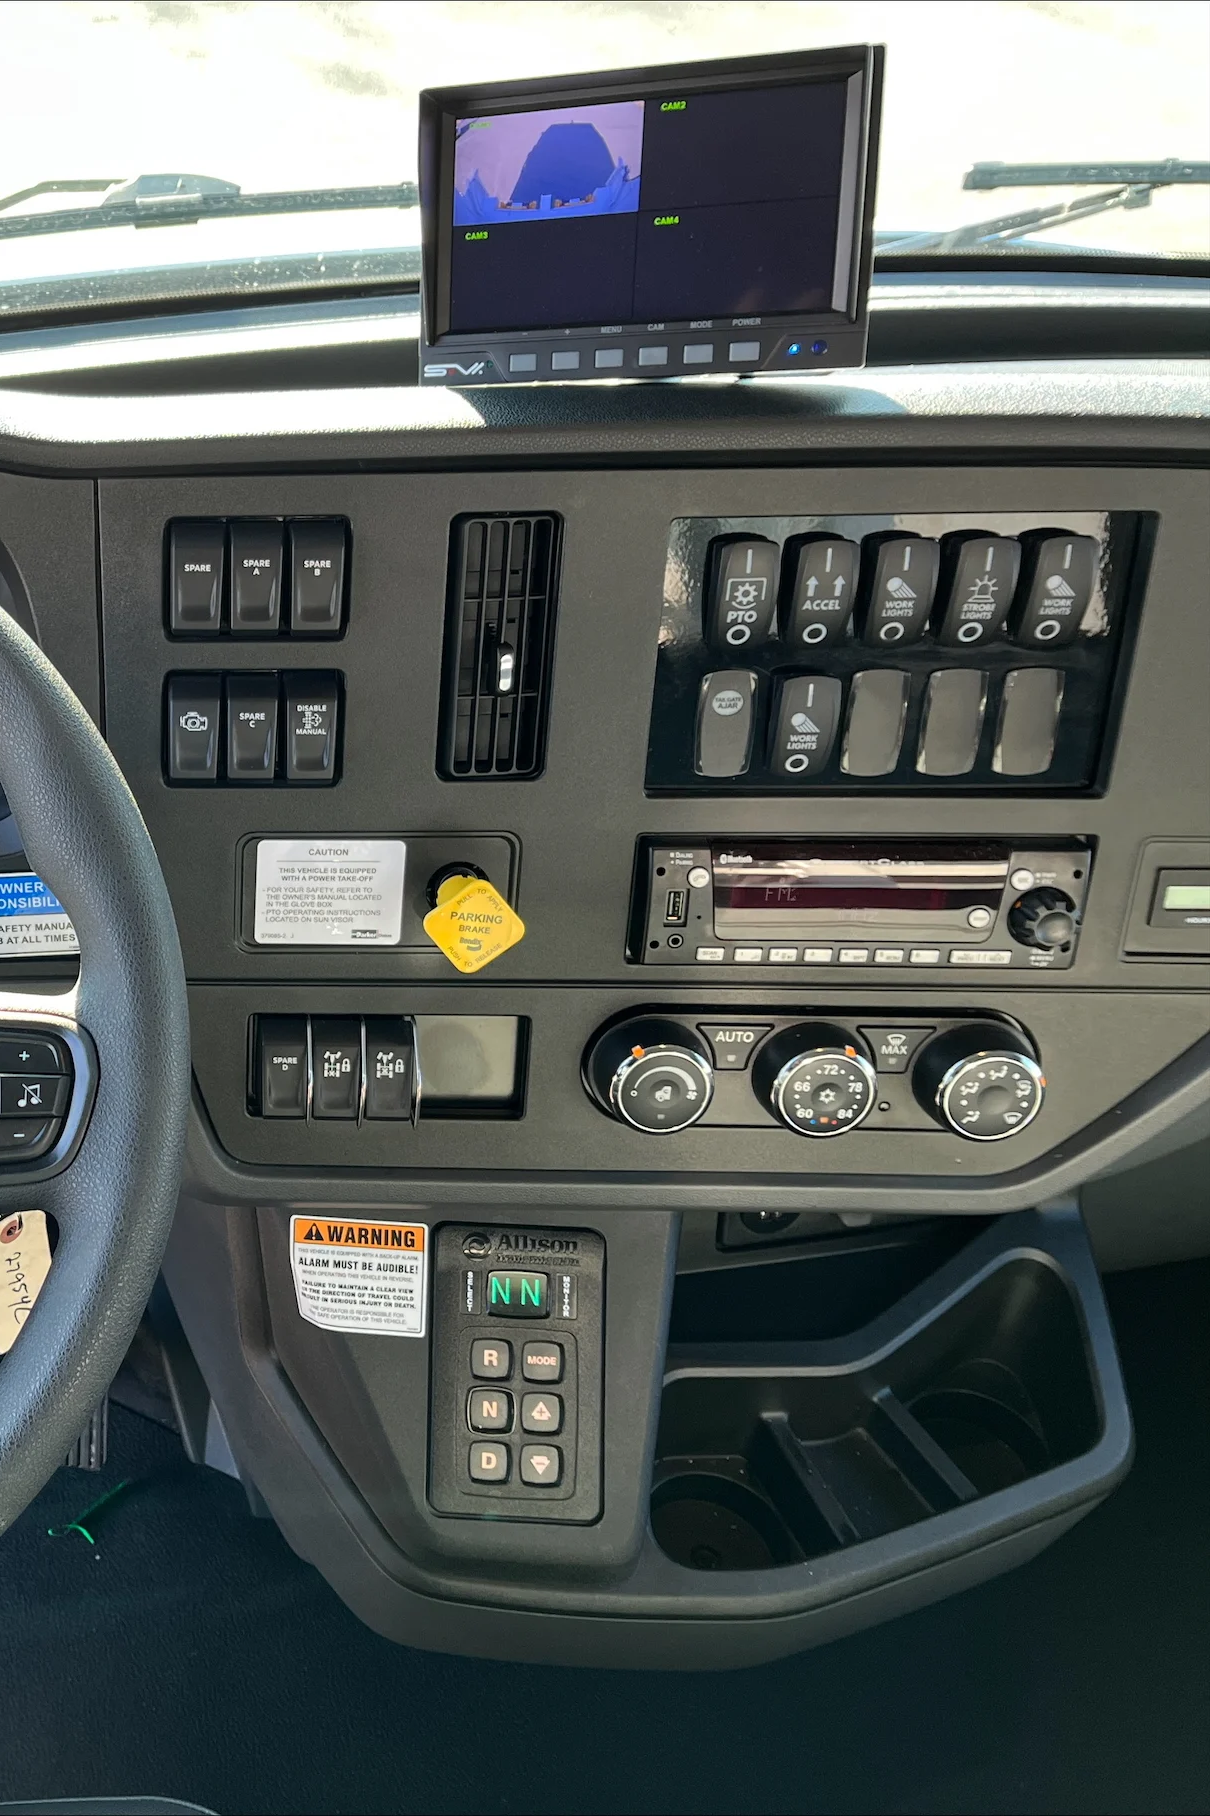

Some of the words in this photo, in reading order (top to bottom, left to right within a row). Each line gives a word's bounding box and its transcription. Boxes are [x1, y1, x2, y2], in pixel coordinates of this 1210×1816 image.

[660, 101, 686, 111] CAM2
[654, 216, 679, 226] CAM4
[465, 231, 489, 240] CAM3
[601, 326, 622, 334] MENU
[648, 323, 664, 331] CAM
[690, 321, 712, 329] MODE
[733, 318, 761, 326] POWER
[184, 564, 211, 572] SPARE
[304, 560, 331, 568] SPARE
[314, 568, 320, 576] B
[802, 600, 840, 610] ACCEL
[962, 604, 995, 612] STROBE
[1044, 599, 1073, 607] WORK
[882, 609, 913, 617] LIGHTS
[1039, 607, 1072, 615] LIGHTS
[726, 611, 757, 623] PTO
[249, 720, 255, 728] C
[790, 734, 818, 742] WORK
[457, 894, 472, 906] PULL
[487, 895, 503, 912] APPLY
[450, 912, 503, 924] PARKING
[35, 922, 73, 931] MANUA
[459, 925, 490, 934] BRAKE
[8, 937, 19, 945] AT
[44, 934, 75, 943] TIMES
[459, 937, 484, 945] Bendix
[448, 946, 462, 961] PUSH
[475, 943, 502, 963] RELEASE
[715, 1032, 754, 1043] AUTO
[881, 1045, 907, 1055] MAX
[823, 1065, 839, 1075] 72
[794, 1081, 811, 1092] 66
[848, 1082, 863, 1093] 78
[796, 1108, 813, 1119] 60
[837, 1109, 853, 1119] 84
[327, 1225, 415, 1248] WARNING
[497, 1235, 578, 1253] Allison
[298, 1257, 329, 1268] ALARM
[333, 1260, 358, 1270] MUST
[362, 1262, 373, 1271] BE
[376, 1263, 419, 1274] AUDIBLE!
[491, 1277, 511, 1305] N
[521, 1278, 540, 1306] N
[483, 1350, 498, 1366] R
[527, 1356, 556, 1366] MODE
[482, 1401, 498, 1418] N
[481, 1452, 497, 1469] D
